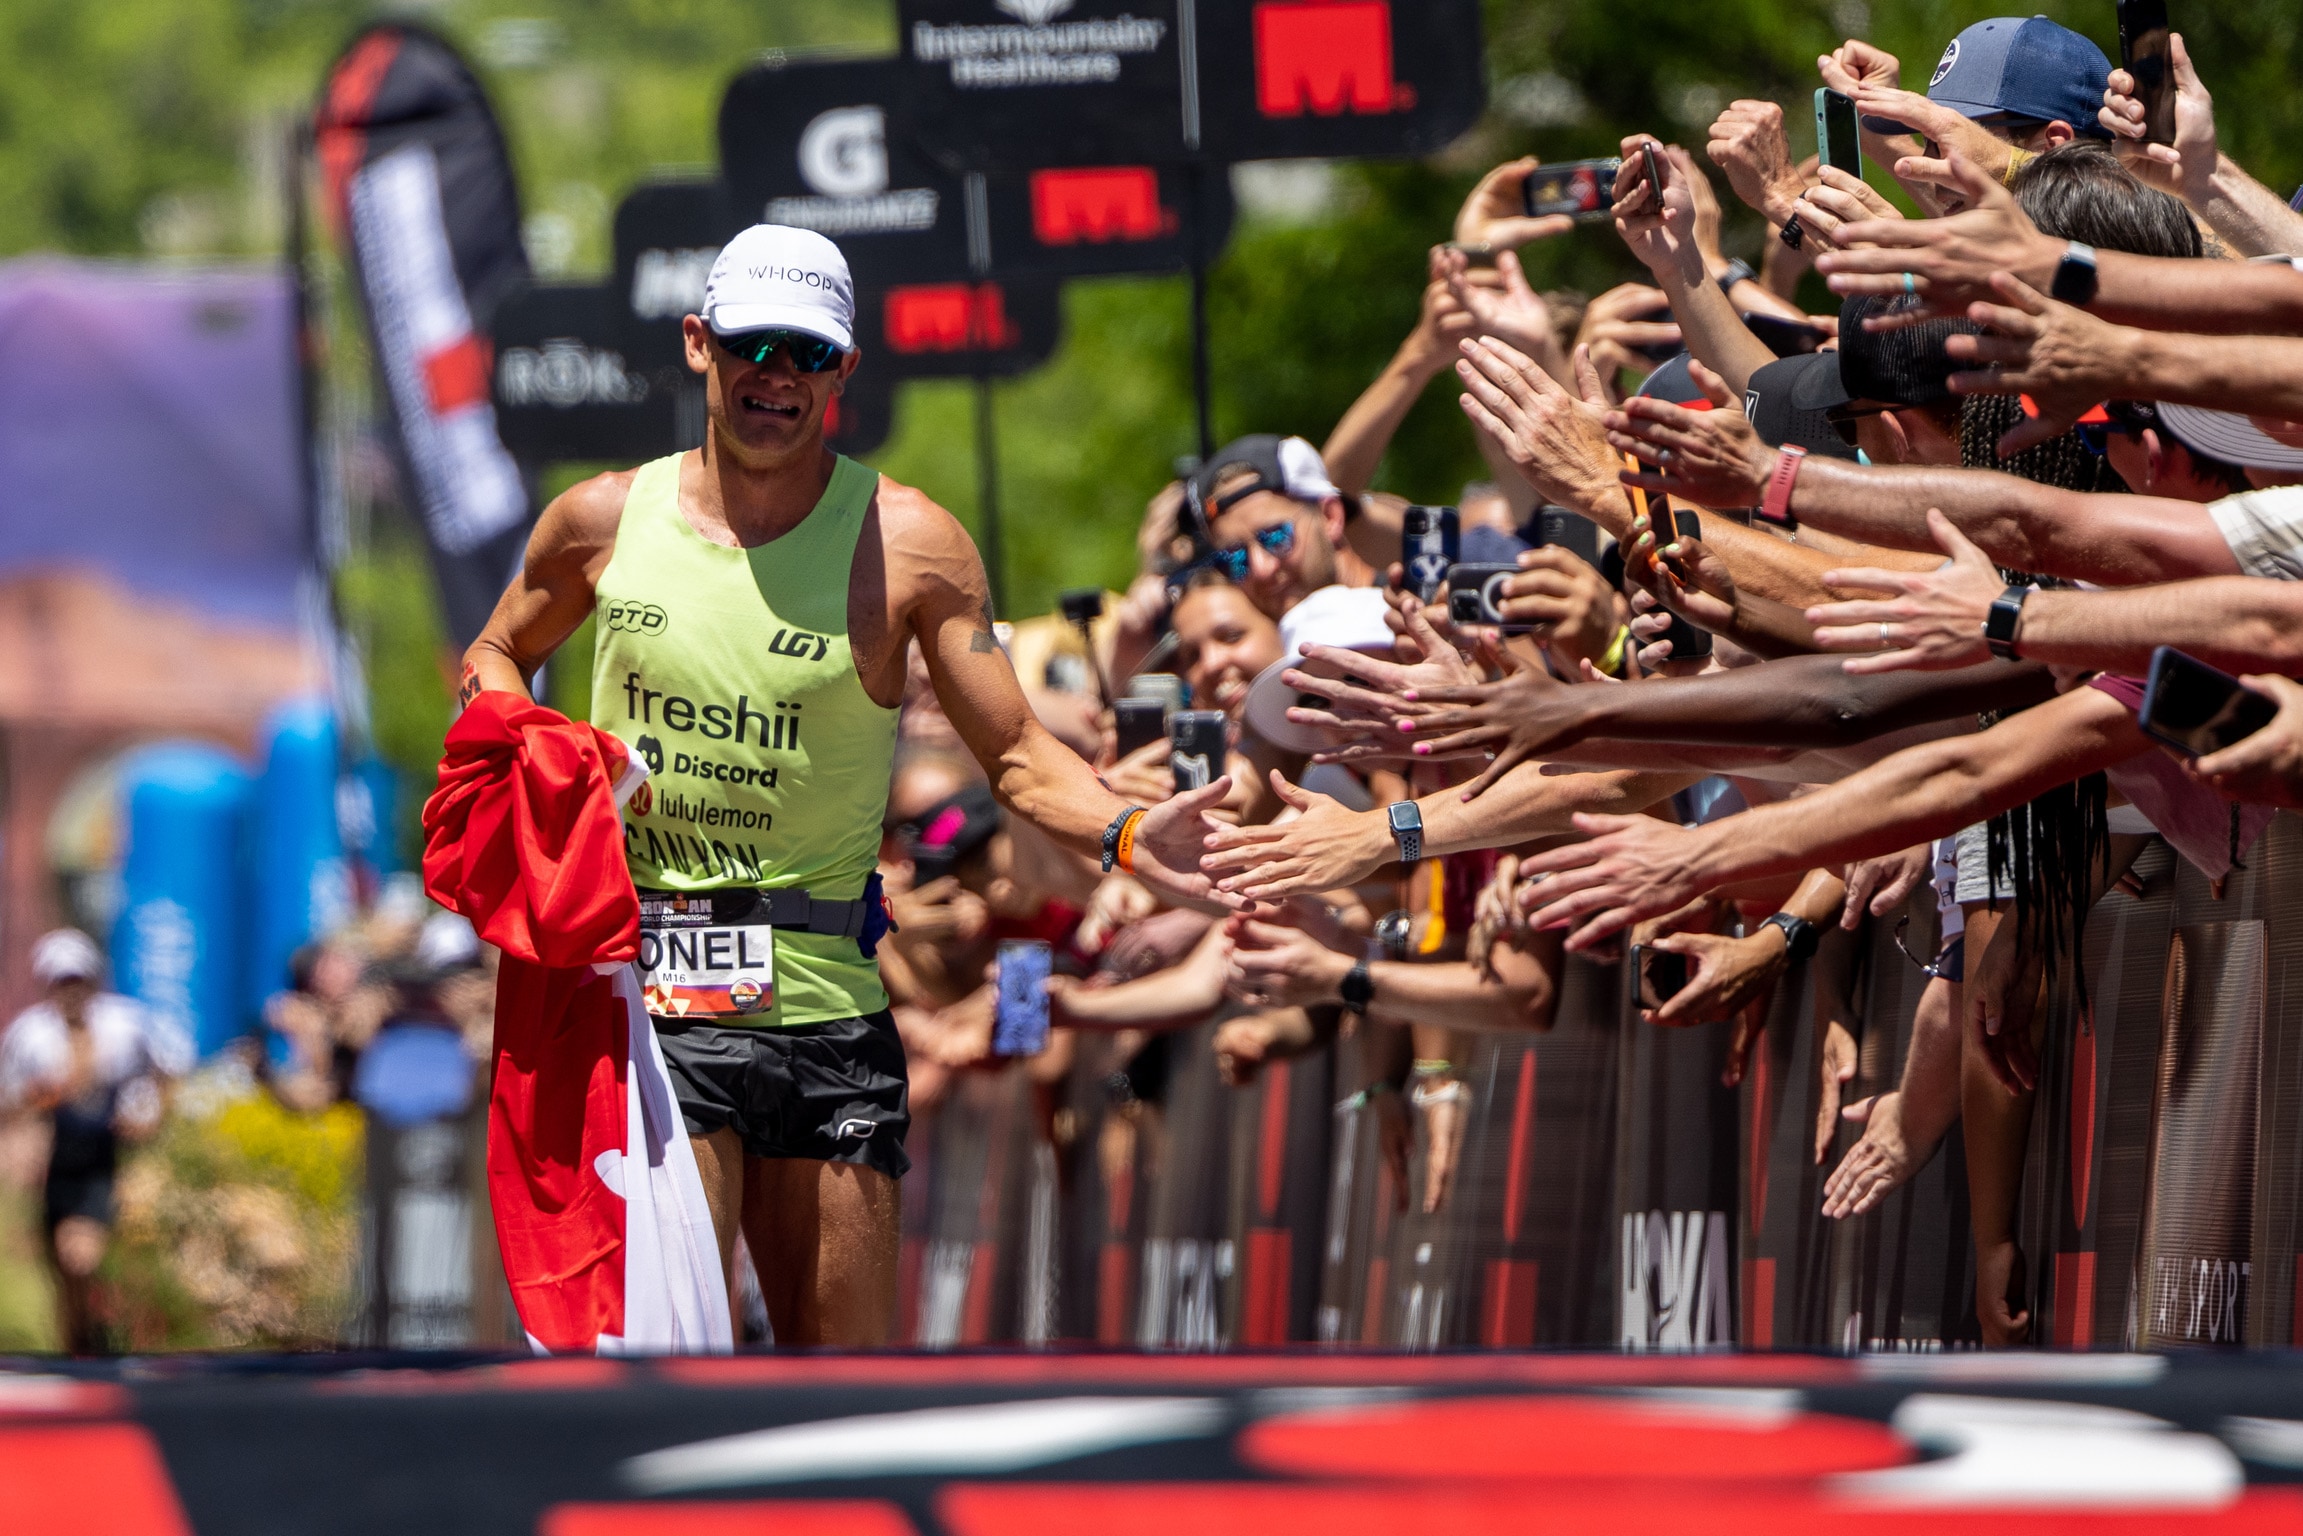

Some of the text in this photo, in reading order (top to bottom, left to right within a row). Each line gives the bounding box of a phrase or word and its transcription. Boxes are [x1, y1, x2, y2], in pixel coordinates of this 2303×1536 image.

[748, 265, 832, 291] WHOOP
[608, 607, 664, 628] PTO
[623, 672, 802, 751] freshii
[673, 752, 778, 788] Discord
[660, 788, 773, 831] lululemon
[625, 821, 764, 882] CANYON
[661, 912, 713, 922] CHAMPIONSHIP
[637, 930, 765, 971] ONEL
[662, 973, 686, 983] M16
